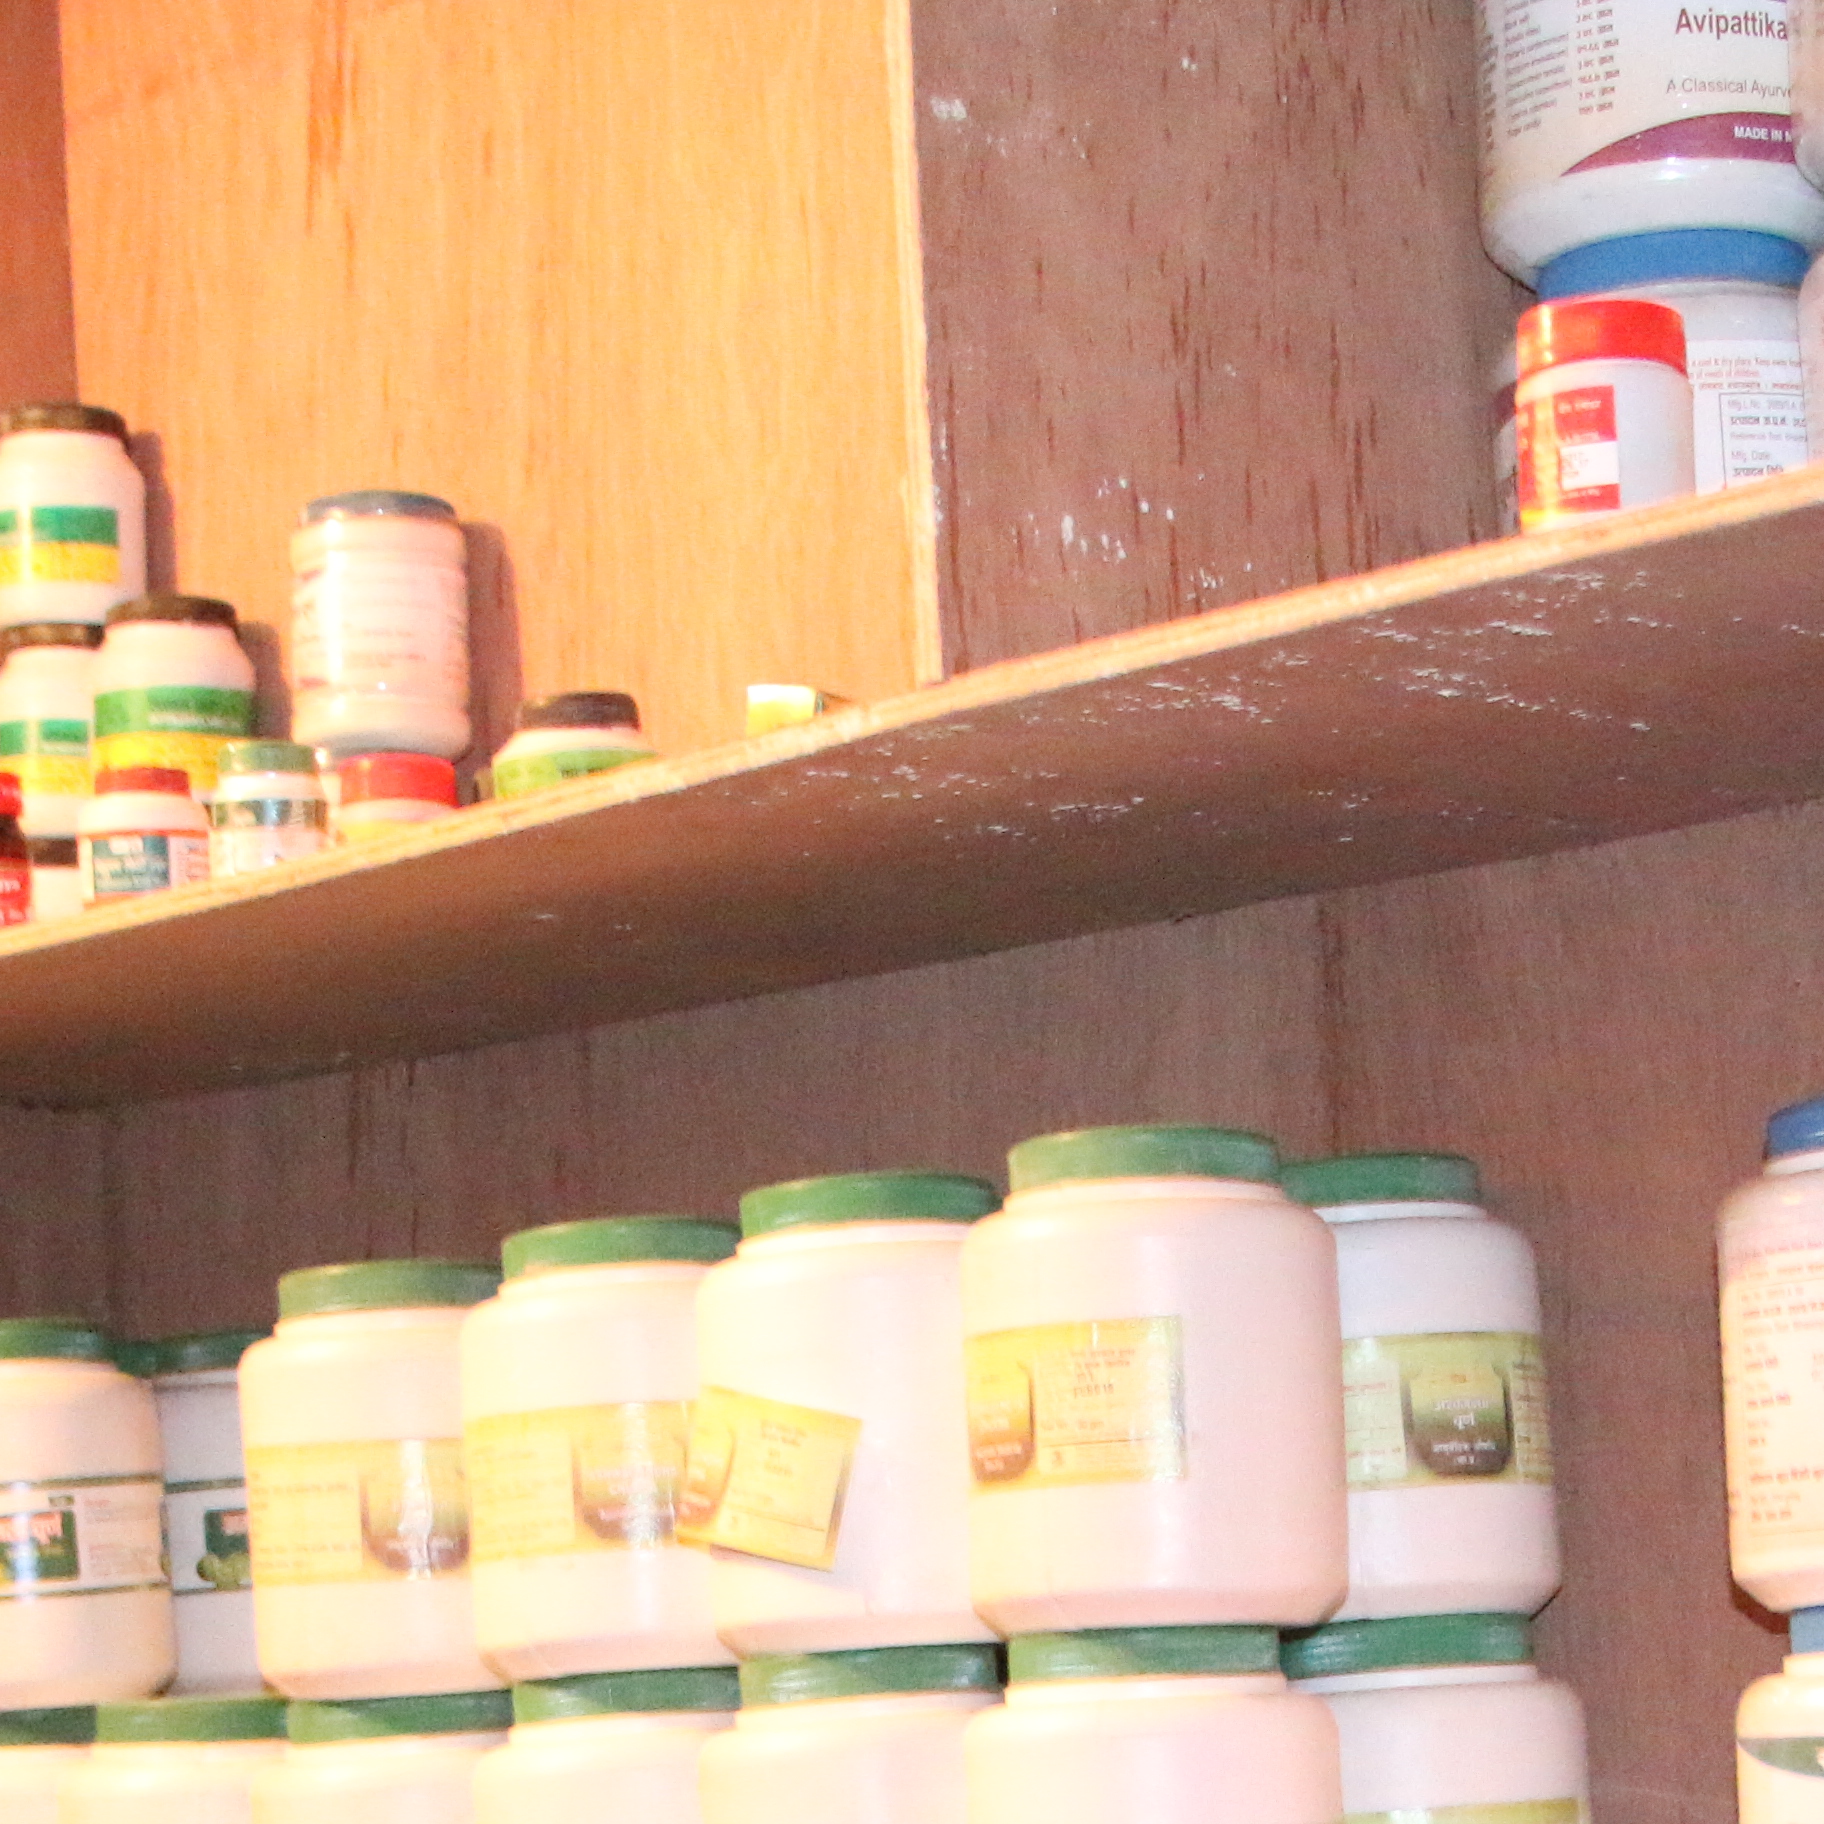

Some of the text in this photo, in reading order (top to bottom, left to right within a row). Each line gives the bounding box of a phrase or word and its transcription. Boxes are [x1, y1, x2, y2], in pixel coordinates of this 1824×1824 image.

[1666, 78, 1747, 95] A Classical
[1734, 126, 1767, 140] MADE
[1771, 128, 1783, 141] IN
